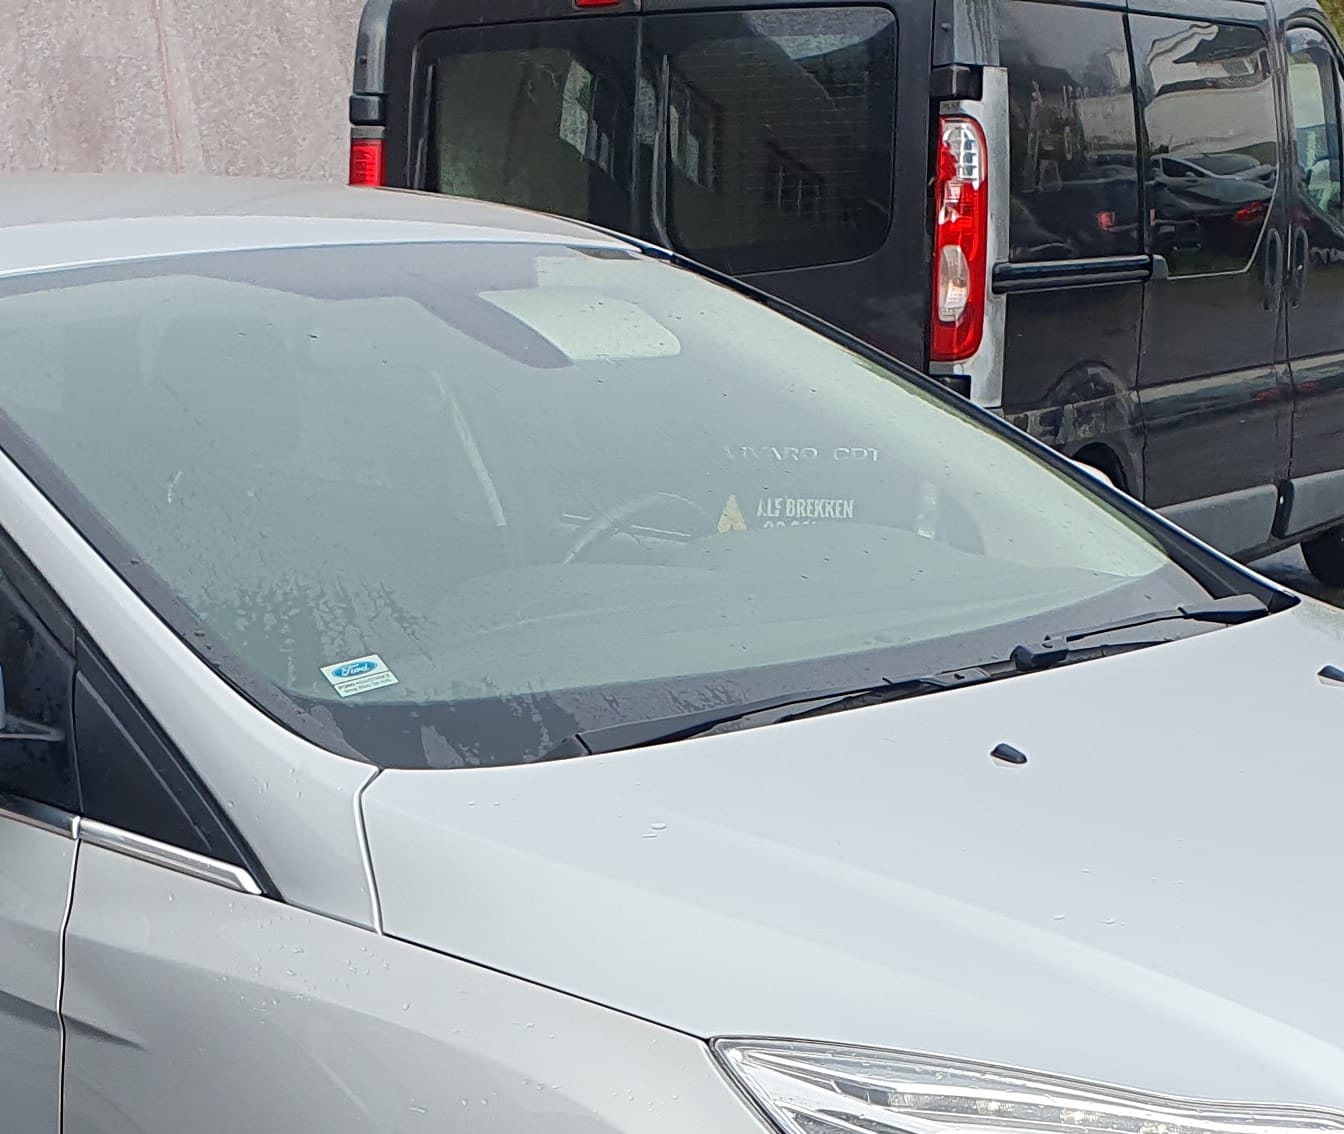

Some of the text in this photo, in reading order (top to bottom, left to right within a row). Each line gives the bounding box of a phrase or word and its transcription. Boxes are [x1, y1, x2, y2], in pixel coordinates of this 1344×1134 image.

[757, 498, 853, 518] ALF BREKKEN
[341, 663, 370, 677] Ford
